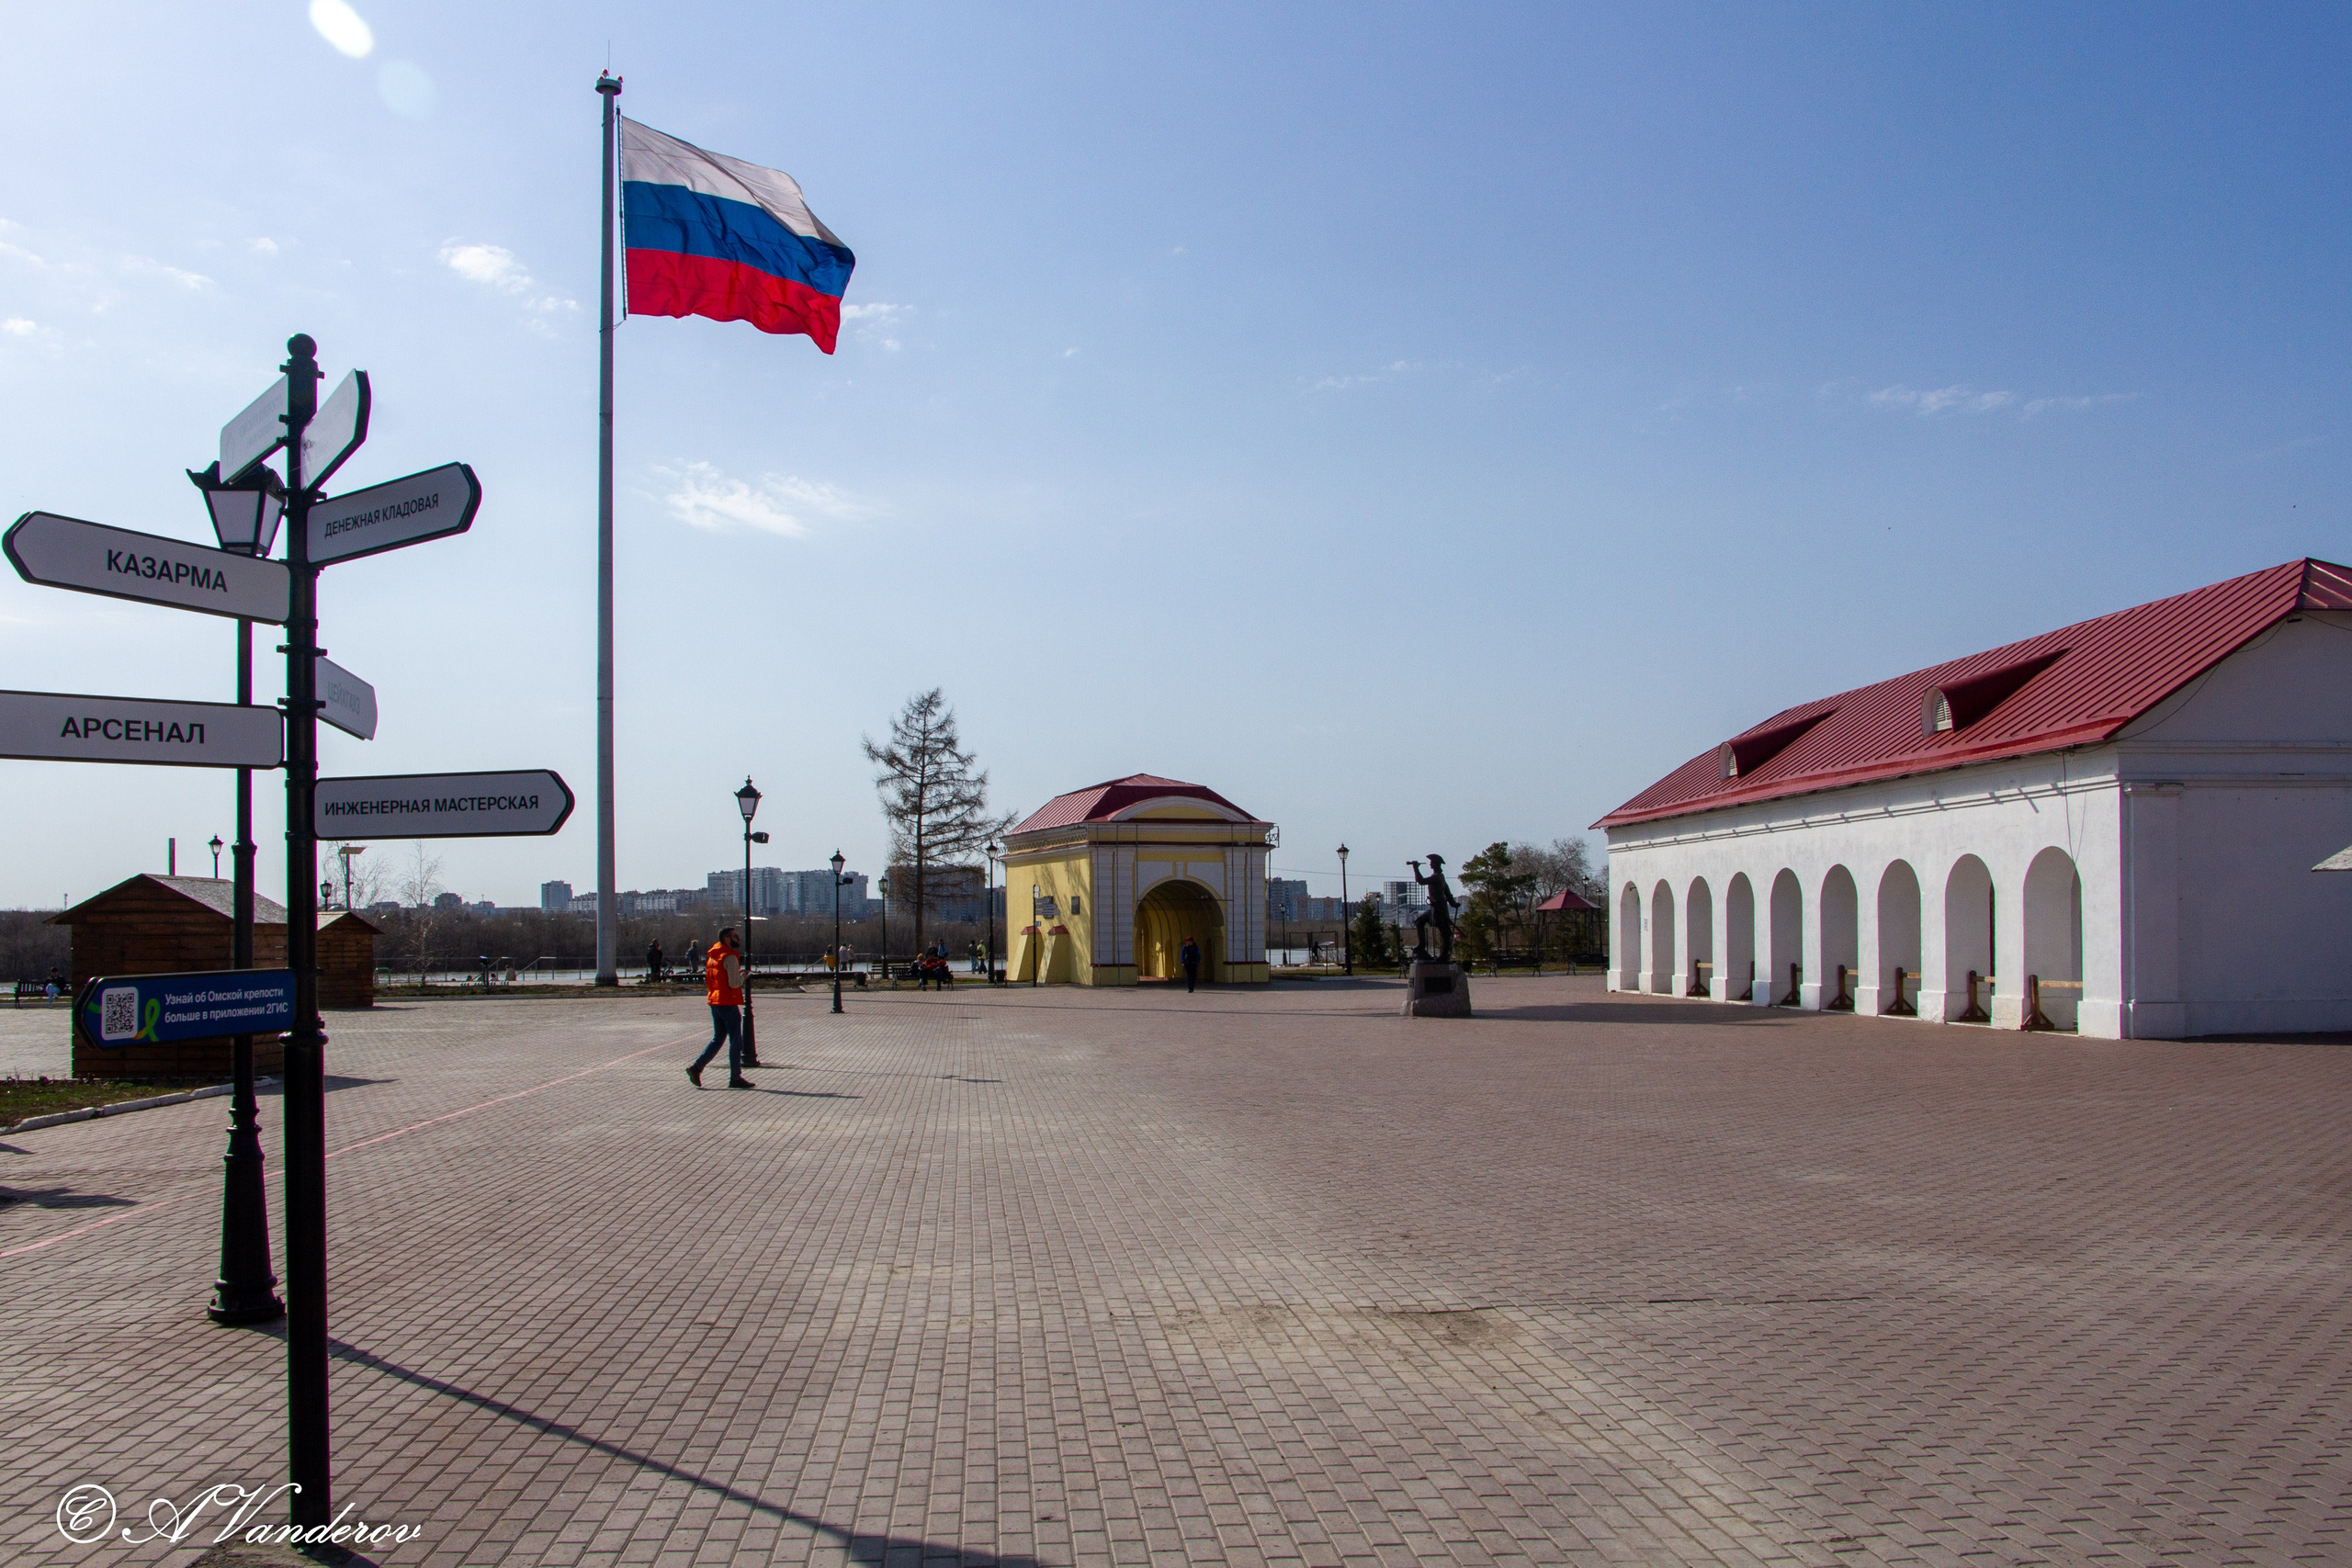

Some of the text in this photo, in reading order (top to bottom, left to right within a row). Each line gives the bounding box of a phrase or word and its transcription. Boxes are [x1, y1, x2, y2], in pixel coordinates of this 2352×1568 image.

[324, 492, 439, 540] ДЕНЕЖНАЯ КЛАДОВАЯ
[106, 548, 229, 593] КАЗАРМА
[327, 680, 361, 716] ЦЕЙХГАУЗ
[60, 716, 205, 744] АРСЕНАЛ
[324, 795, 539, 817] ИНЖЕНЕРНАЯ МАСТЕРСКАЯ
[165, 988, 283, 1005] Узнай об Омской крепости
[164, 1002, 288, 1022] больше в приложении 2ГИС
